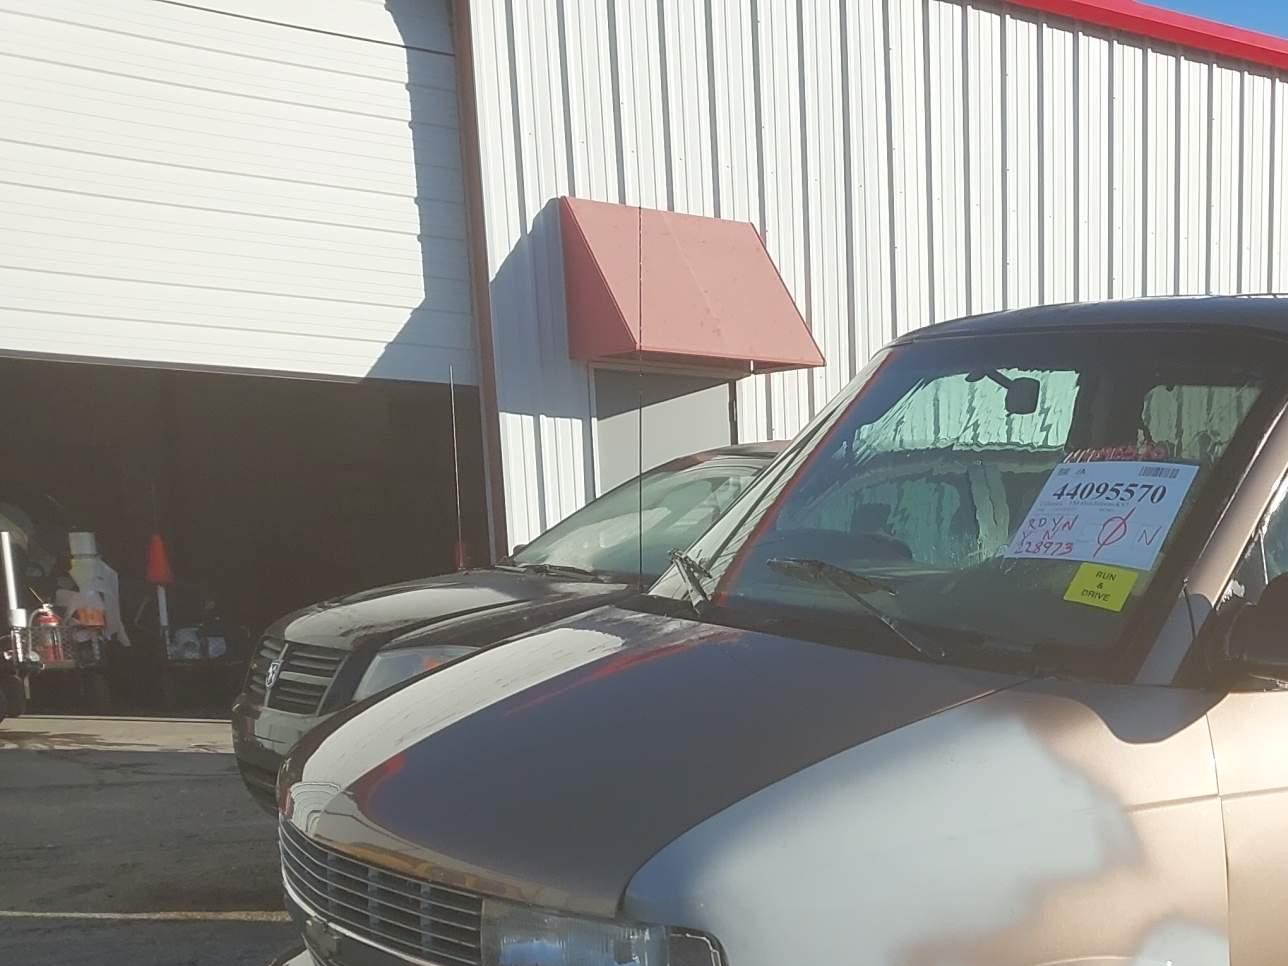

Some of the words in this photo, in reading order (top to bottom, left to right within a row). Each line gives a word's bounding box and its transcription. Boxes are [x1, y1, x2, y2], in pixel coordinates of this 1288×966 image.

[1053, 481, 1167, 505] 44095570
[1095, 570, 1117, 581] RUN
[1096, 582, 1104, 590] &
[1081, 588, 1111, 602] DRIVE
